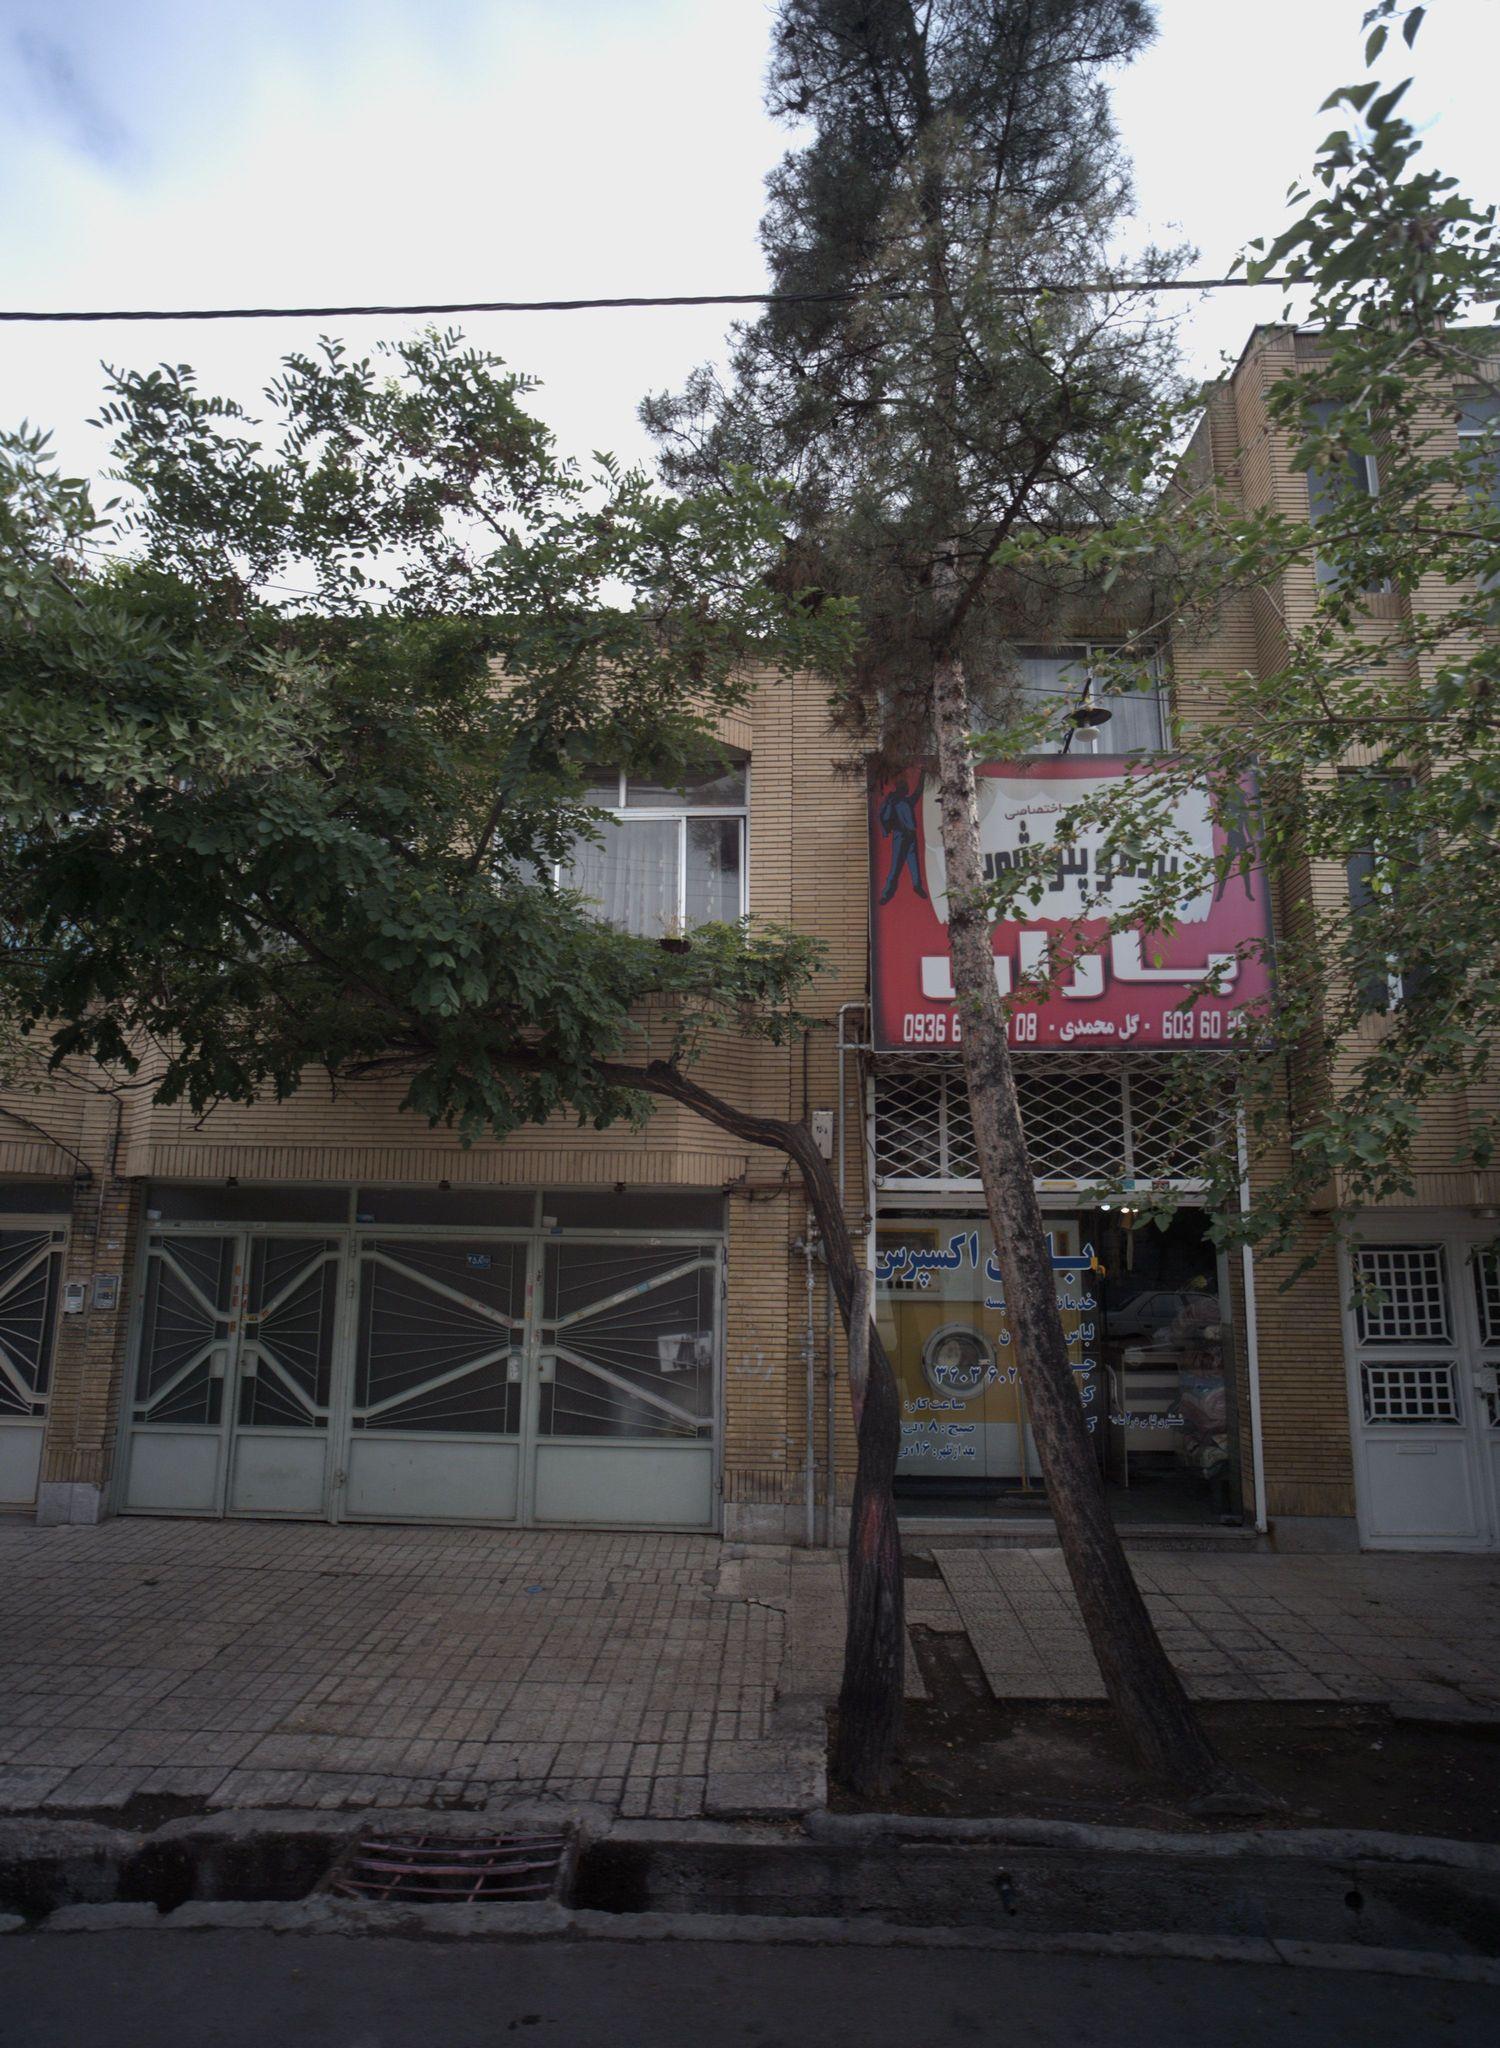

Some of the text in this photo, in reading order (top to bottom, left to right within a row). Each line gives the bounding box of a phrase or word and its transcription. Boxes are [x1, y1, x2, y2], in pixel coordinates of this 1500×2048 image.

[1005, 803, 1062, 820] اختصاصی
[904, 1013, 945, 1043] 0936
[1016, 1012, 1038, 1042] 08
[1059, 1013, 1141, 1044] گل محمدی
[1162, 1011, 1194, 1039] 603
[1200, 1010, 1221, 1039] 60
[876, 1229, 979, 1288] اکسپرس
[934, 1365, 1024, 1385] ۳۶۰۳ ۶۰۲
[929, 1397, 966, 1411] ساعت
